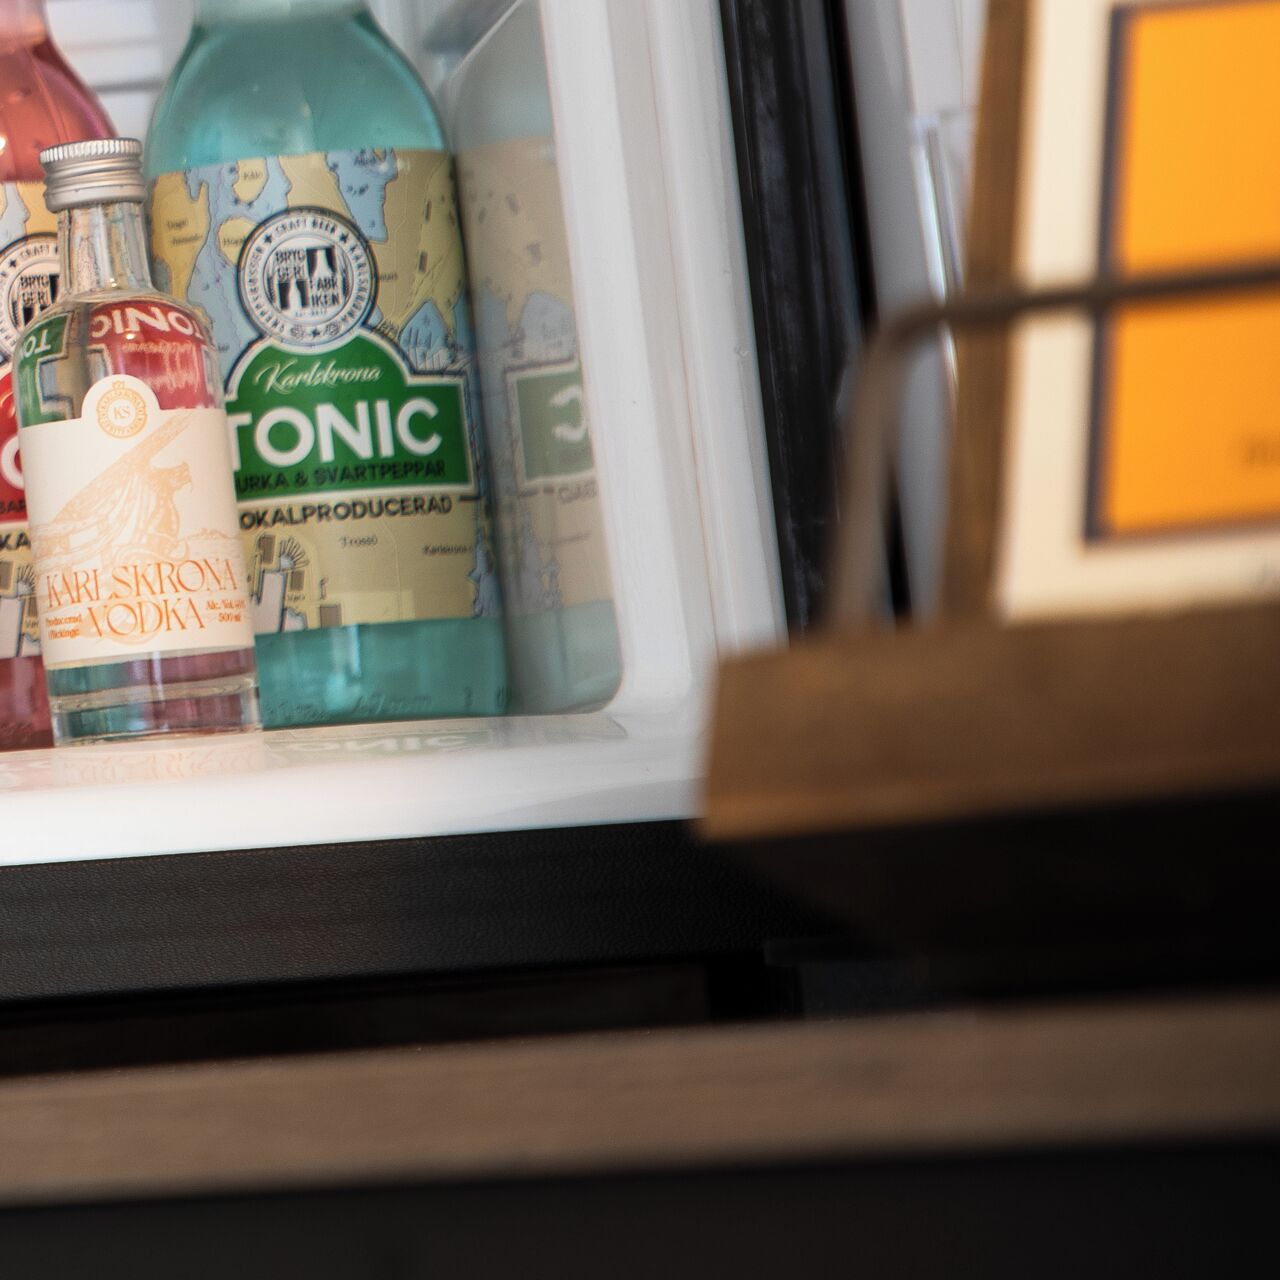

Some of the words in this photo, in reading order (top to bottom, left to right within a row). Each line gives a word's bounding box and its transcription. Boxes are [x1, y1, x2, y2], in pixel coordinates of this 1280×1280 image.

[254, 356, 383, 395] Karlskrona
[234, 472, 288, 495] URKA
[240, 495, 452, 530] OKALPRODUCERAD
[46, 558, 238, 608] KARLSKRONA
[87, 597, 206, 637] VODKA
